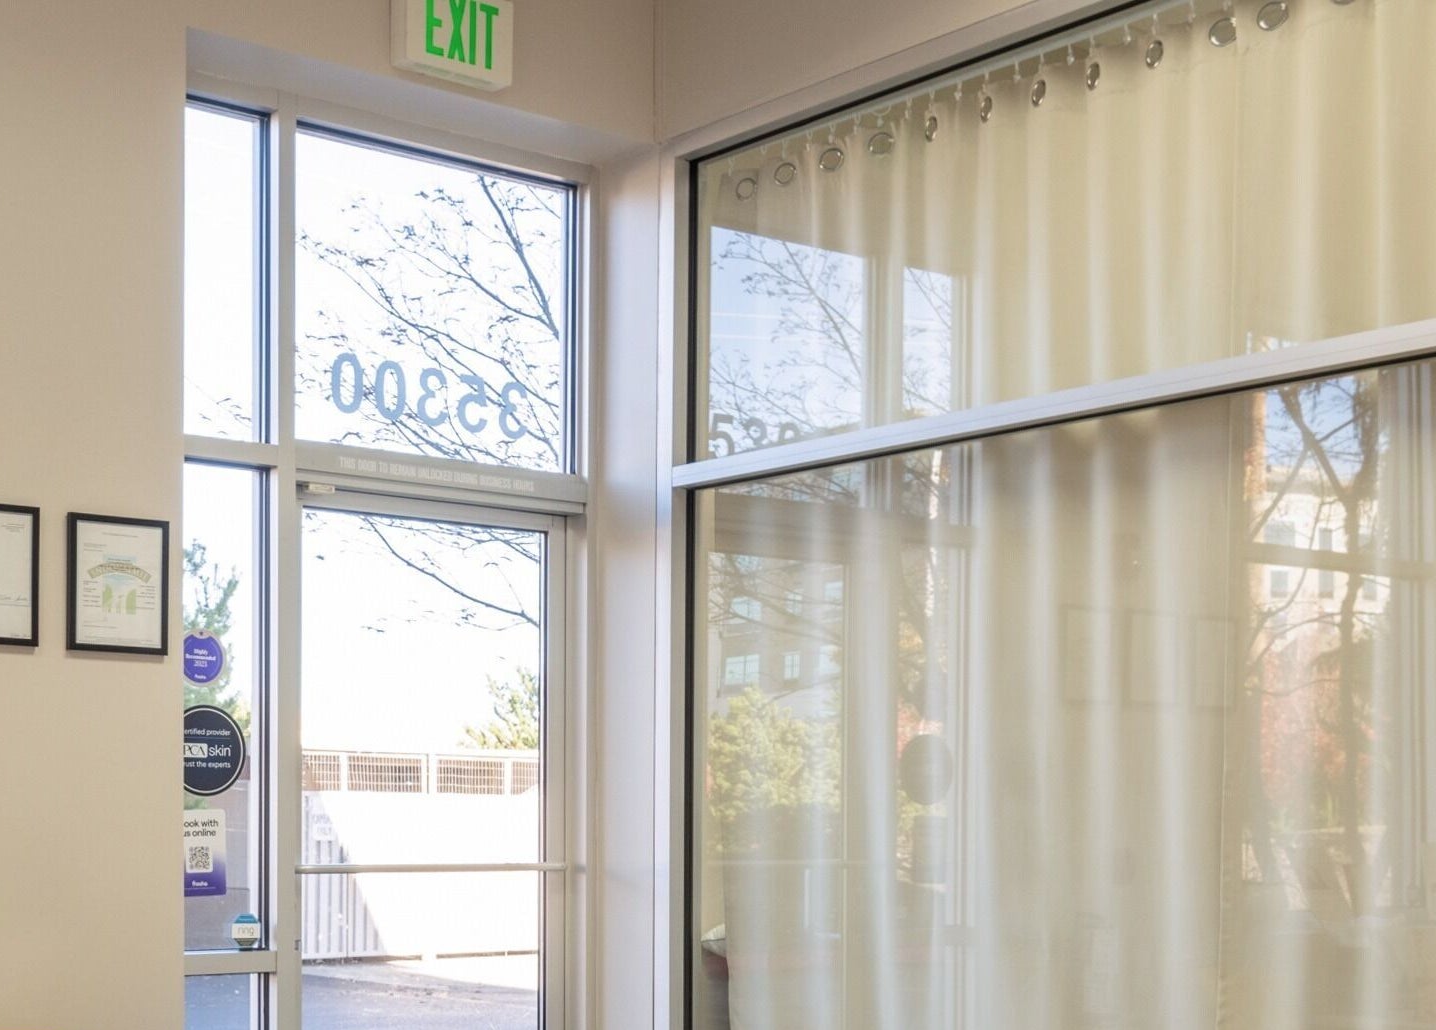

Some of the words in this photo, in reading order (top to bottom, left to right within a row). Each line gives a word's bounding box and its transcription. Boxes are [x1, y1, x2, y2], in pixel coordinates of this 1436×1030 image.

[426, 0, 500, 70] EXIT
[340, 456, 357, 470] THIS
[358, 458, 377, 472] DOOR
[378, 460, 389, 474] TO
[390, 462, 417, 477] REMAIN
[417, 466, 453, 482] UNLOCKED
[454, 470, 478, 485] DURING
[479, 474, 512, 490] BUSINESS
[513, 478, 535, 493] HOURS
[183, 728, 205, 736] ertified
[208, 744, 231, 757] skin
[207, 761, 231, 769] experts
[183, 819, 200, 828] ook
[201, 819, 219, 828] with
[192, 829, 217, 837] online
[237, 926, 255, 937] ring
